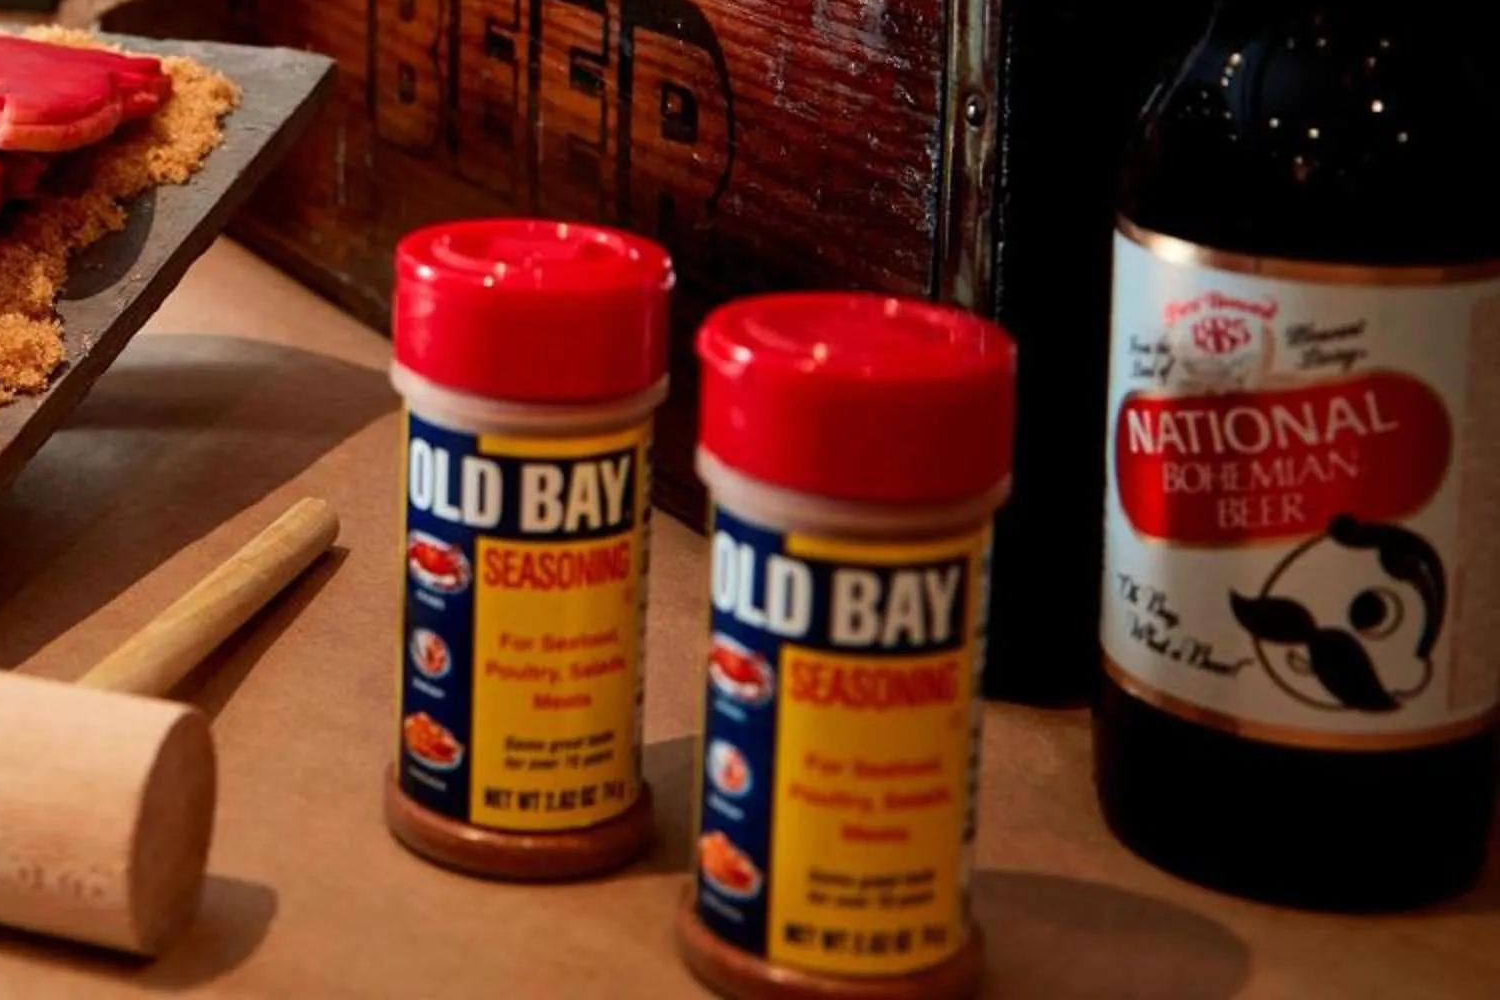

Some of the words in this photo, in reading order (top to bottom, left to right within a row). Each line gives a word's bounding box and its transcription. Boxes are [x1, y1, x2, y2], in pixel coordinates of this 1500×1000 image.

[1127, 391, 1398, 454] NATIONAL
[409, 437, 503, 528] OLD
[520, 455, 630, 533] BAY
[1162, 450, 1359, 493] BOHEMIAN
[1217, 493, 1306, 529] BEER
[484, 541, 630, 591] SEASONING
[711, 530, 812, 638] OLD
[830, 564, 960, 646] BAY
